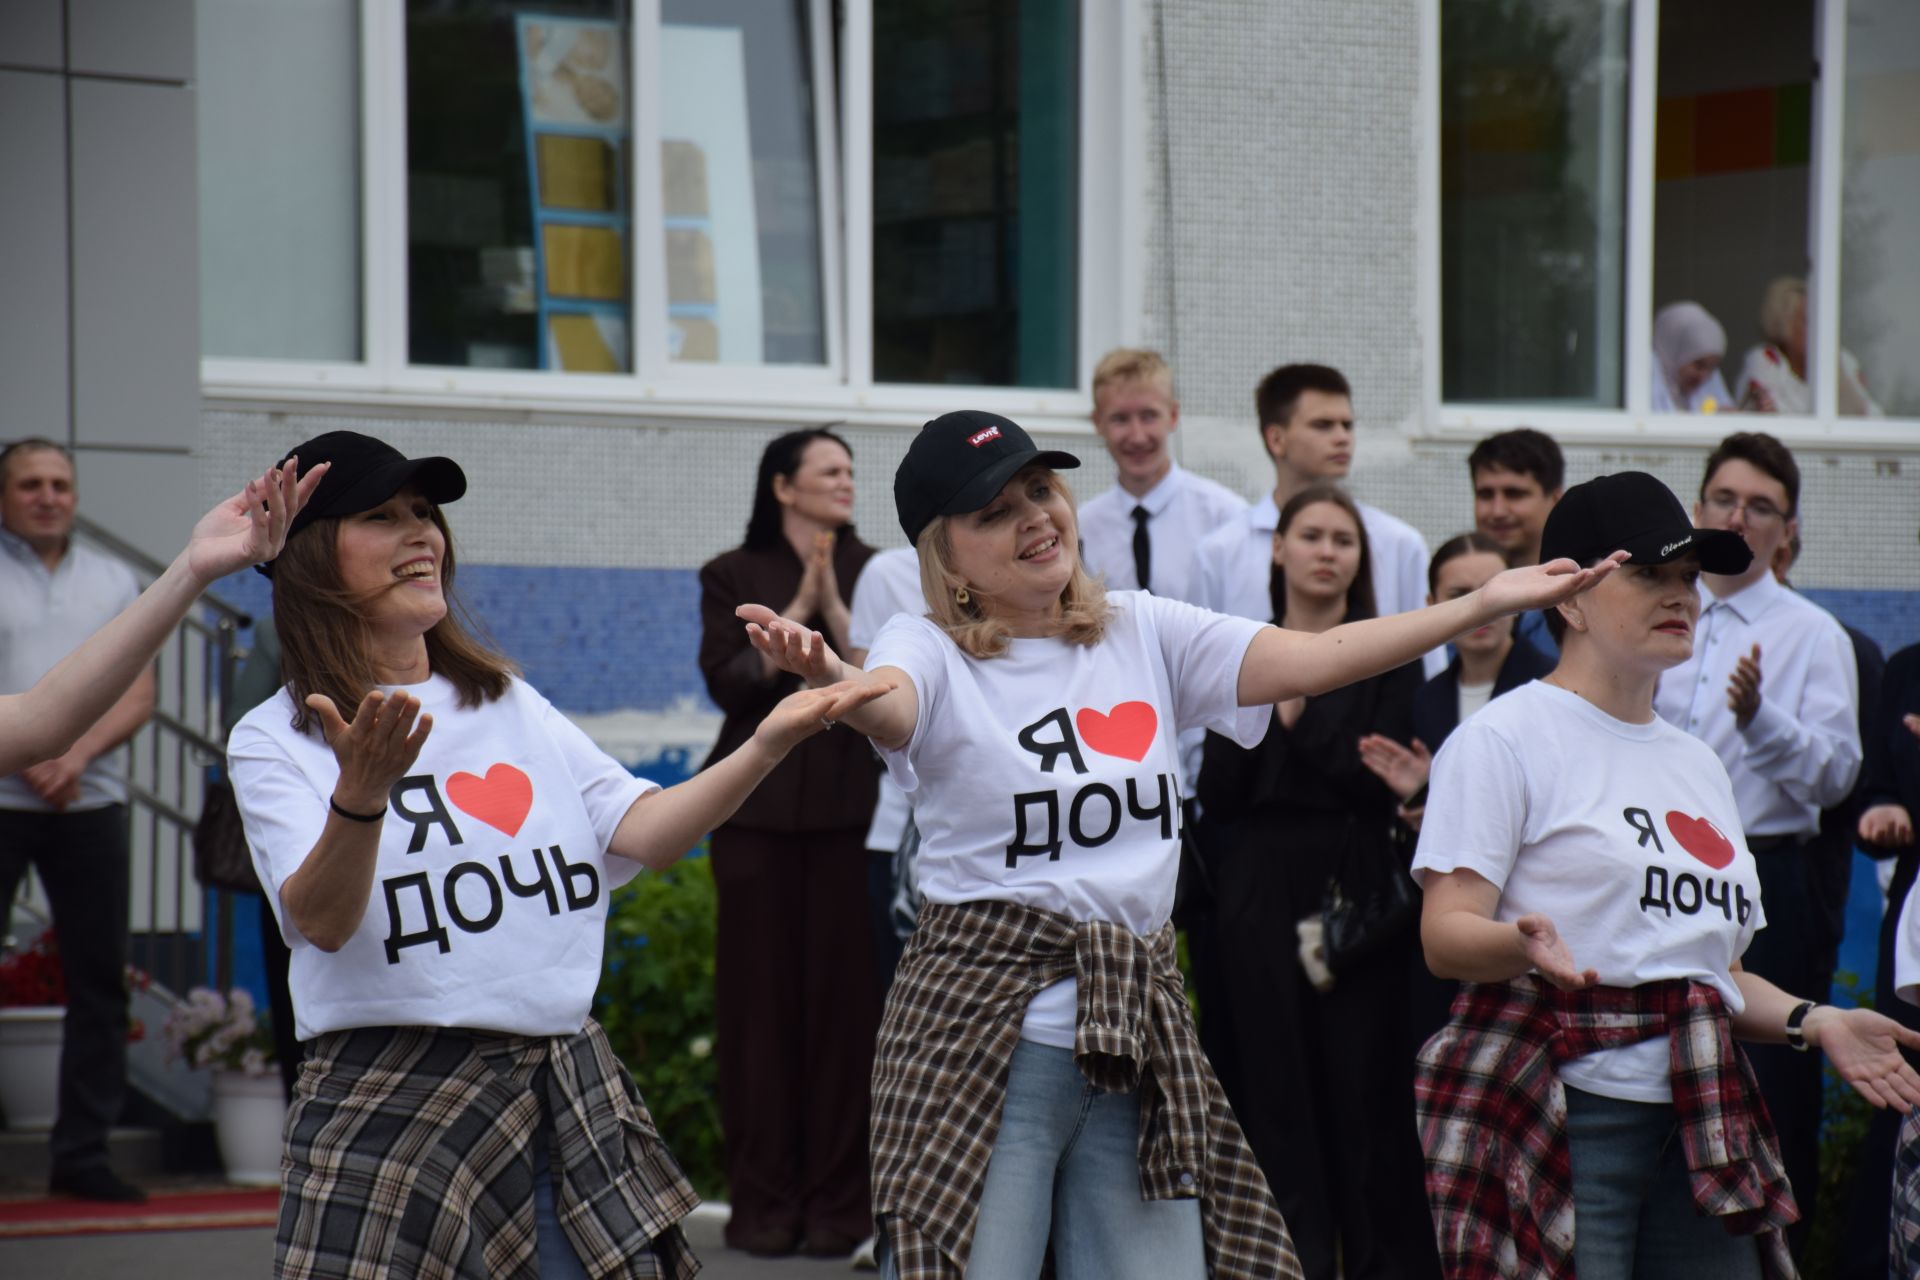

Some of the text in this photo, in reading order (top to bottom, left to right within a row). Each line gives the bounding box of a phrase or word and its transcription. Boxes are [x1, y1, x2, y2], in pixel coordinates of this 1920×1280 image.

[1018, 707, 1089, 774] Я
[389, 774, 464, 855] Я
[1623, 807, 1664, 854] Я
[382, 844, 599, 965] ДОЧЬ
[1640, 865, 1751, 927] ДОЧЬ
